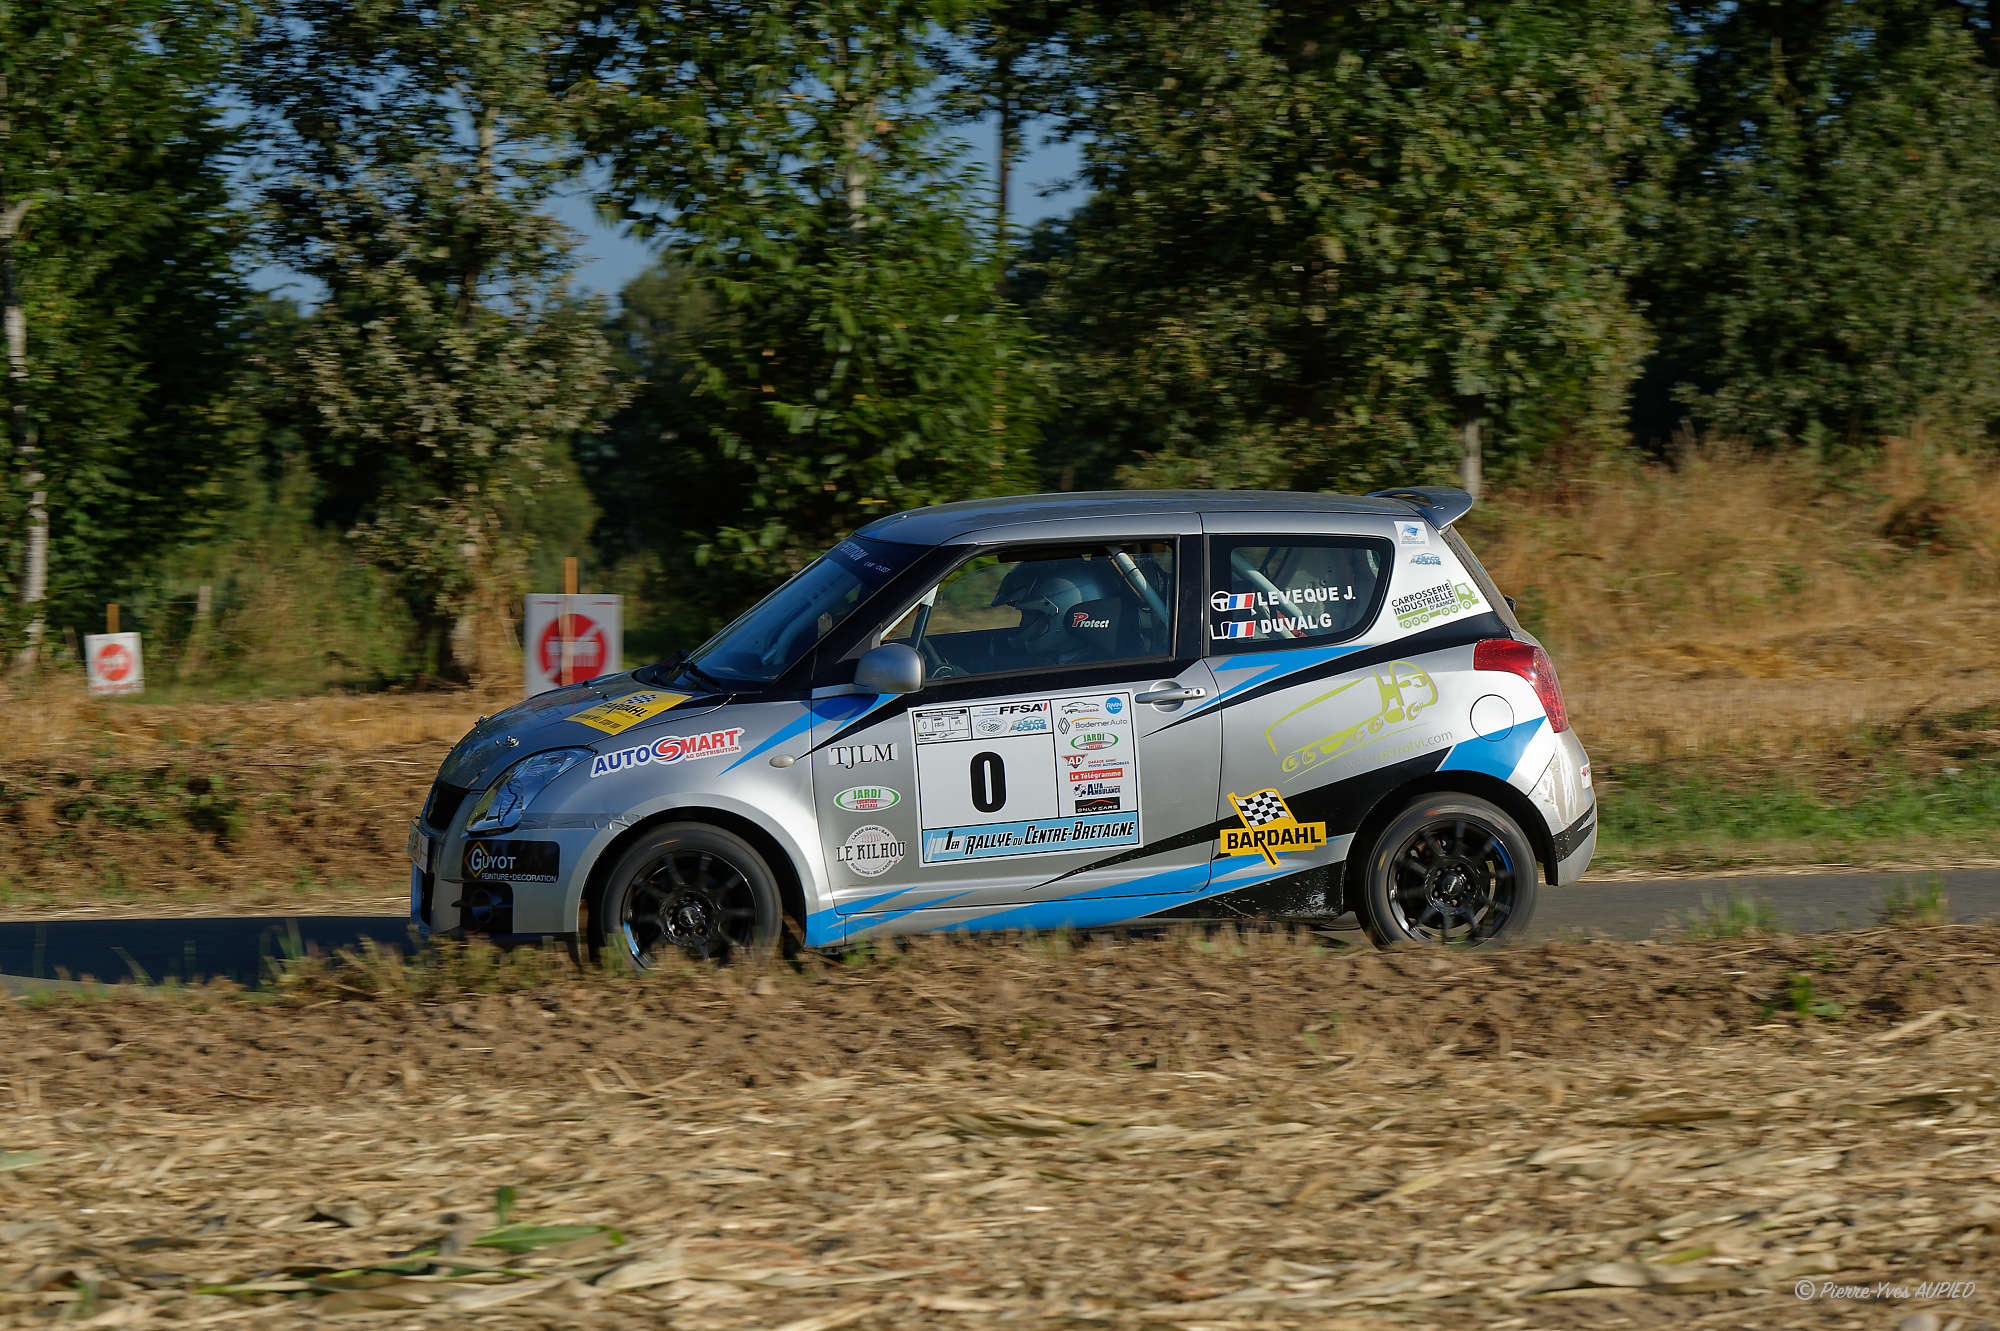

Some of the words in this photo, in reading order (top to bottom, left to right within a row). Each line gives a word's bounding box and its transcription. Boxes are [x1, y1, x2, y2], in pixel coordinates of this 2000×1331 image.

[1257, 586, 1339, 606] LEVEQUE
[1343, 585, 1356, 600] J.
[1391, 583, 1451, 607] CARROSSERIE
[1393, 590, 1454, 616] INDUSTRIELLE
[1072, 612, 1110, 628] Protect
[1000, 703, 1042, 715] FFSA
[1083, 733, 1105, 742] JARDI
[831, 743, 894, 769] TJLM
[1068, 756, 1083, 765] AD
[970, 752, 1007, 813] 0
[853, 789, 881, 799] JARDI
[964, 832, 1013, 855] RALLYE
[1012, 838, 1023, 846] DU
[1024, 821, 1136, 845] CENTRE-BRETAGNE
[1227, 826, 1321, 850] BARDAHL
[471, 848, 516, 871] GUYOT
[836, 845, 853, 862] LE
[857, 842, 906, 860] KILHOU
